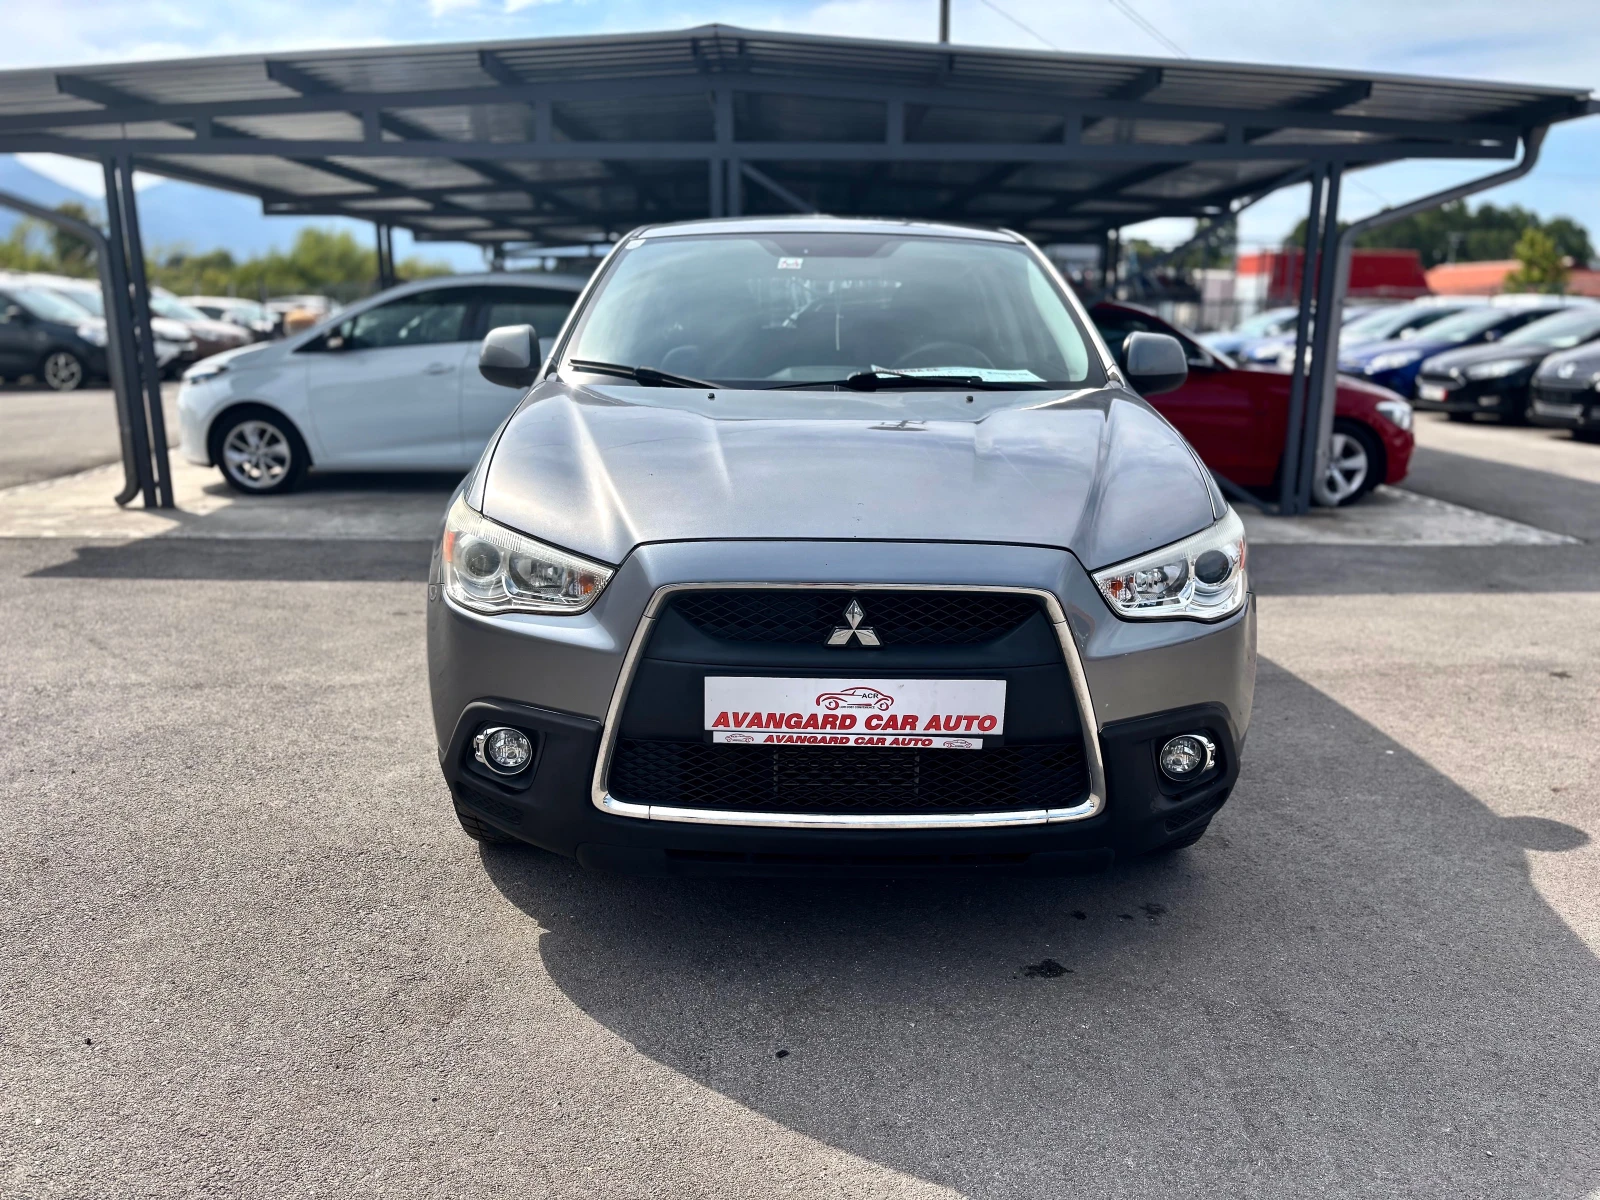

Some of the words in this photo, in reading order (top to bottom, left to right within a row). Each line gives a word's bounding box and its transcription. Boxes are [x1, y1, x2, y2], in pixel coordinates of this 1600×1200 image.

[712, 711, 857, 731] AVANGARD
[864, 714, 919, 731] CAR
[923, 714, 998, 732] AUTO
[763, 734, 850, 745] AVANGARD
[854, 737, 887, 746] CAR
[889, 738, 934, 747] AUTO
